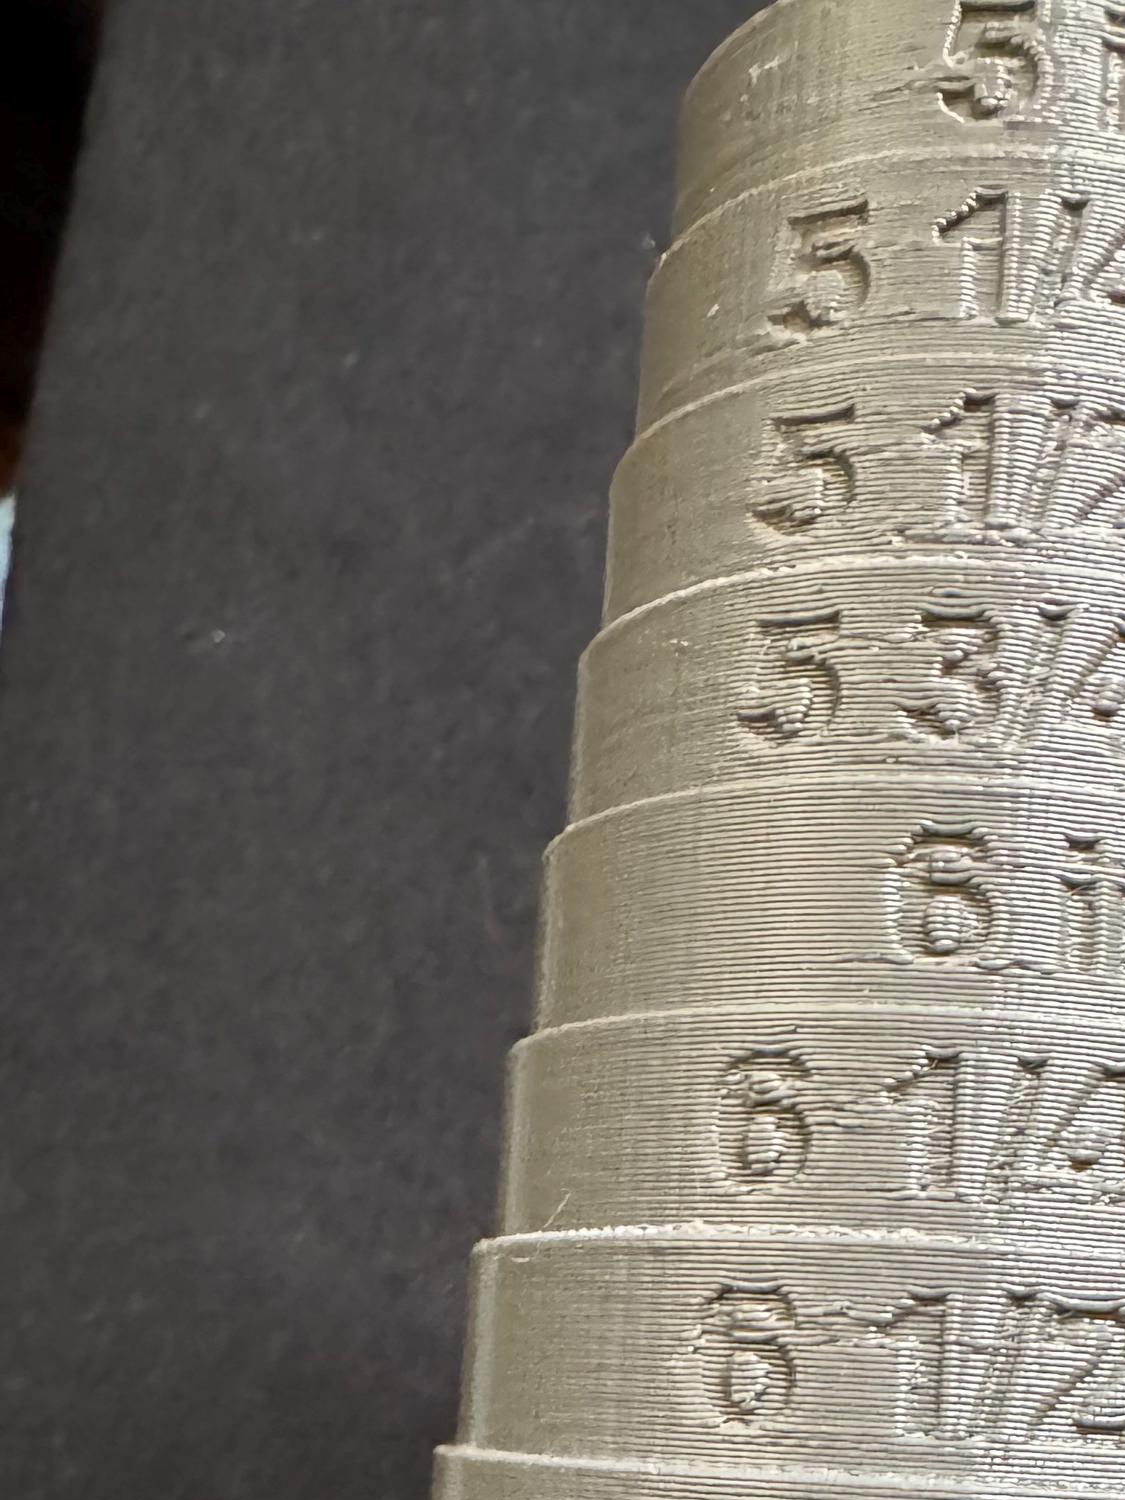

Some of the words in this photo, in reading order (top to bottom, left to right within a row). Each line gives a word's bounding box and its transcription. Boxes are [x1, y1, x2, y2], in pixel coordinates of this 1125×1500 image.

[938, 0, 1044, 123] 5
[763, 200, 870, 346] 5
[748, 402, 856, 545] 5
[735, 610, 842, 740] 5
[884, 820, 998, 965] 6
[708, 1048, 812, 1195] 6
[692, 1284, 796, 1428] 6
